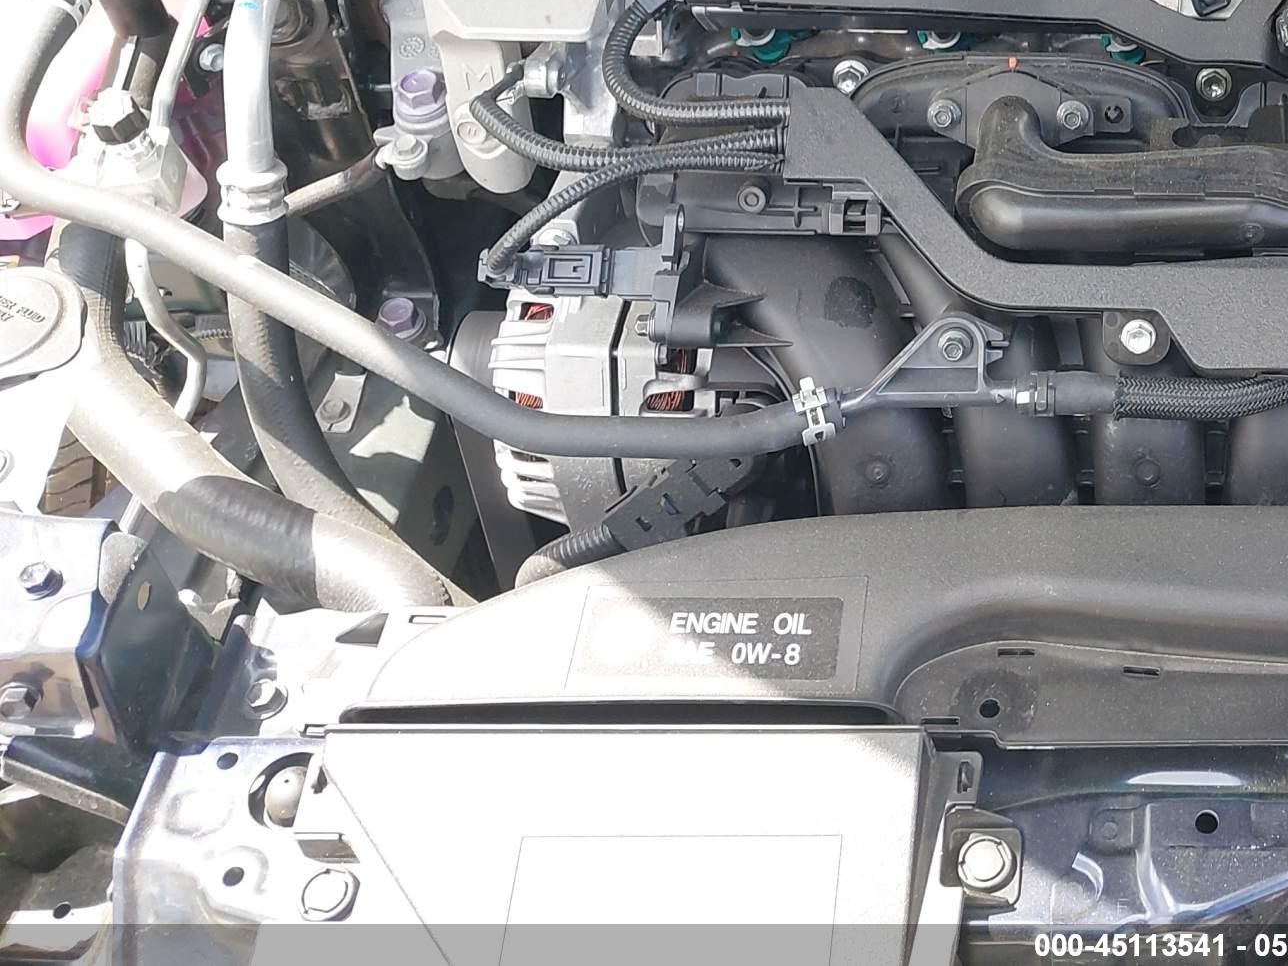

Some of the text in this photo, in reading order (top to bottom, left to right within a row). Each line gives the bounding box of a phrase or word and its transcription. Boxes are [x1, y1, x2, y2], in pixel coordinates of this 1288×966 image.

[669, 612, 812, 635] ENGINE OIL
[731, 642, 801, 665] 0W-8
